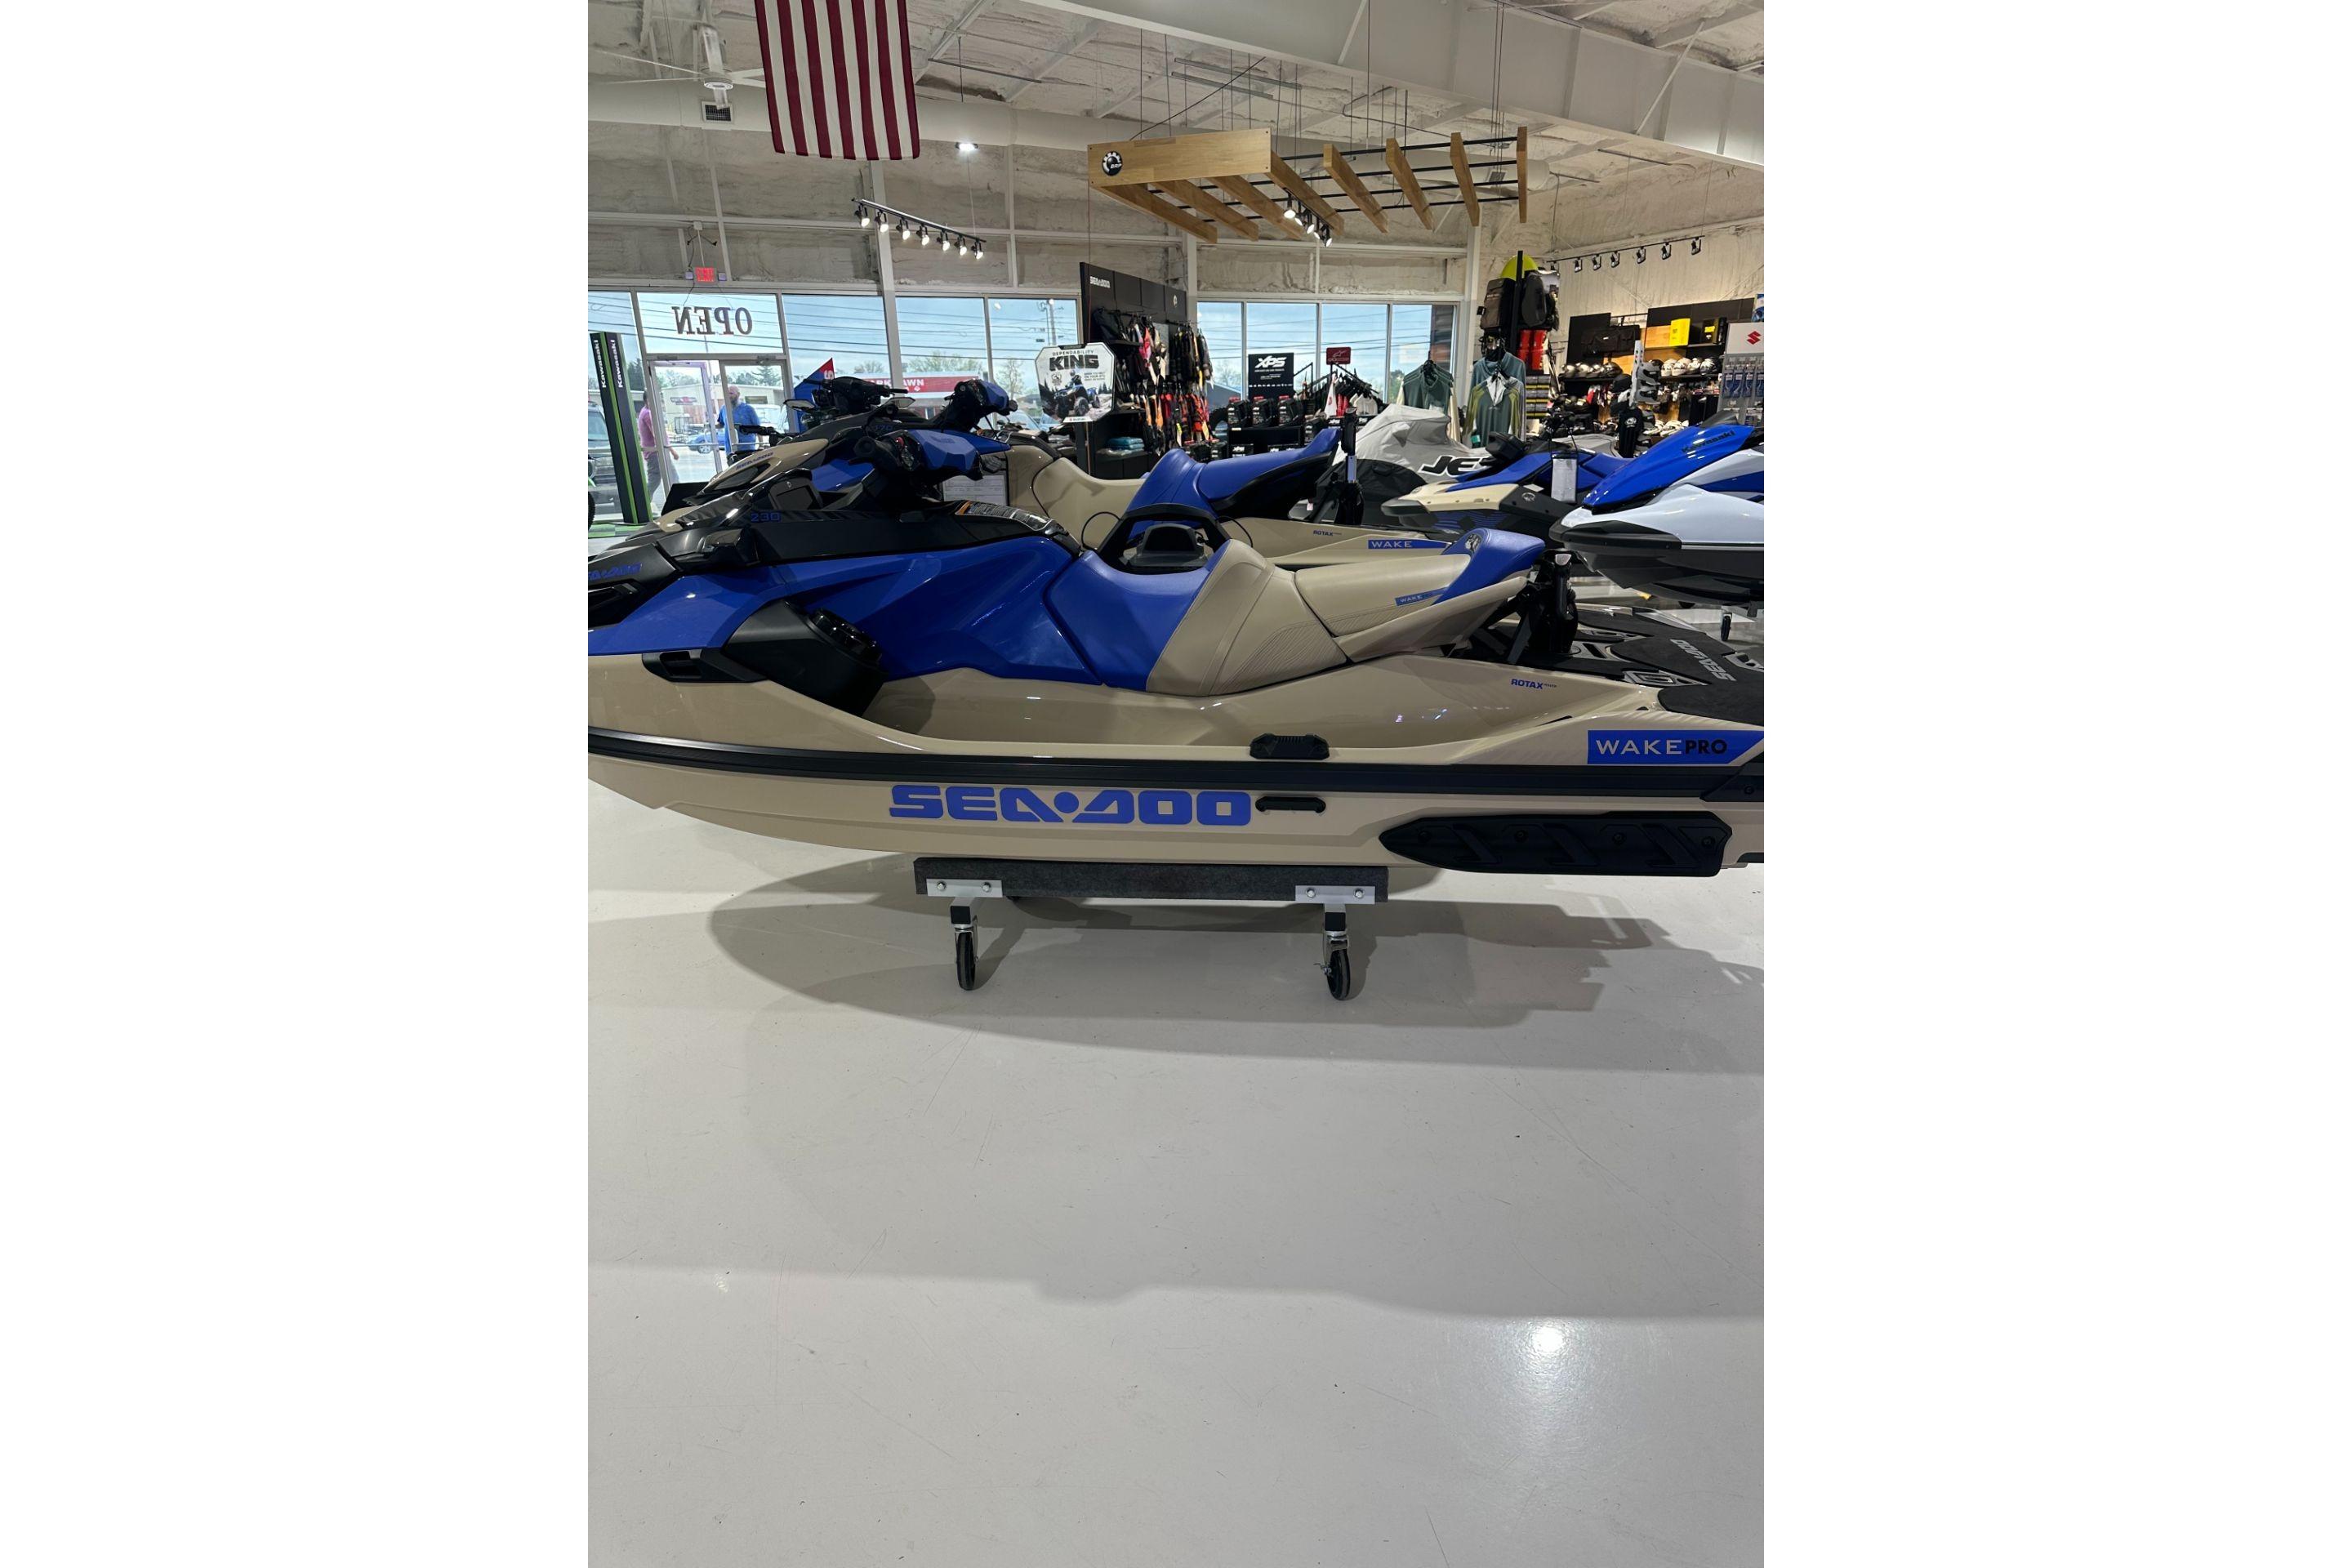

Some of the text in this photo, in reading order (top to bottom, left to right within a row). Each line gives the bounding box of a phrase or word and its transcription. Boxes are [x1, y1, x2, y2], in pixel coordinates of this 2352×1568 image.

[594, 339, 607, 388] Kawasaki
[610, 339, 623, 388] Kawasaki
[1049, 354, 1100, 372] KING
[1254, 355, 1287, 368] XPS
[1418, 455, 1493, 478] JE
[751, 512, 781, 523] 230
[1511, 679, 1544, 689] ROTAX
